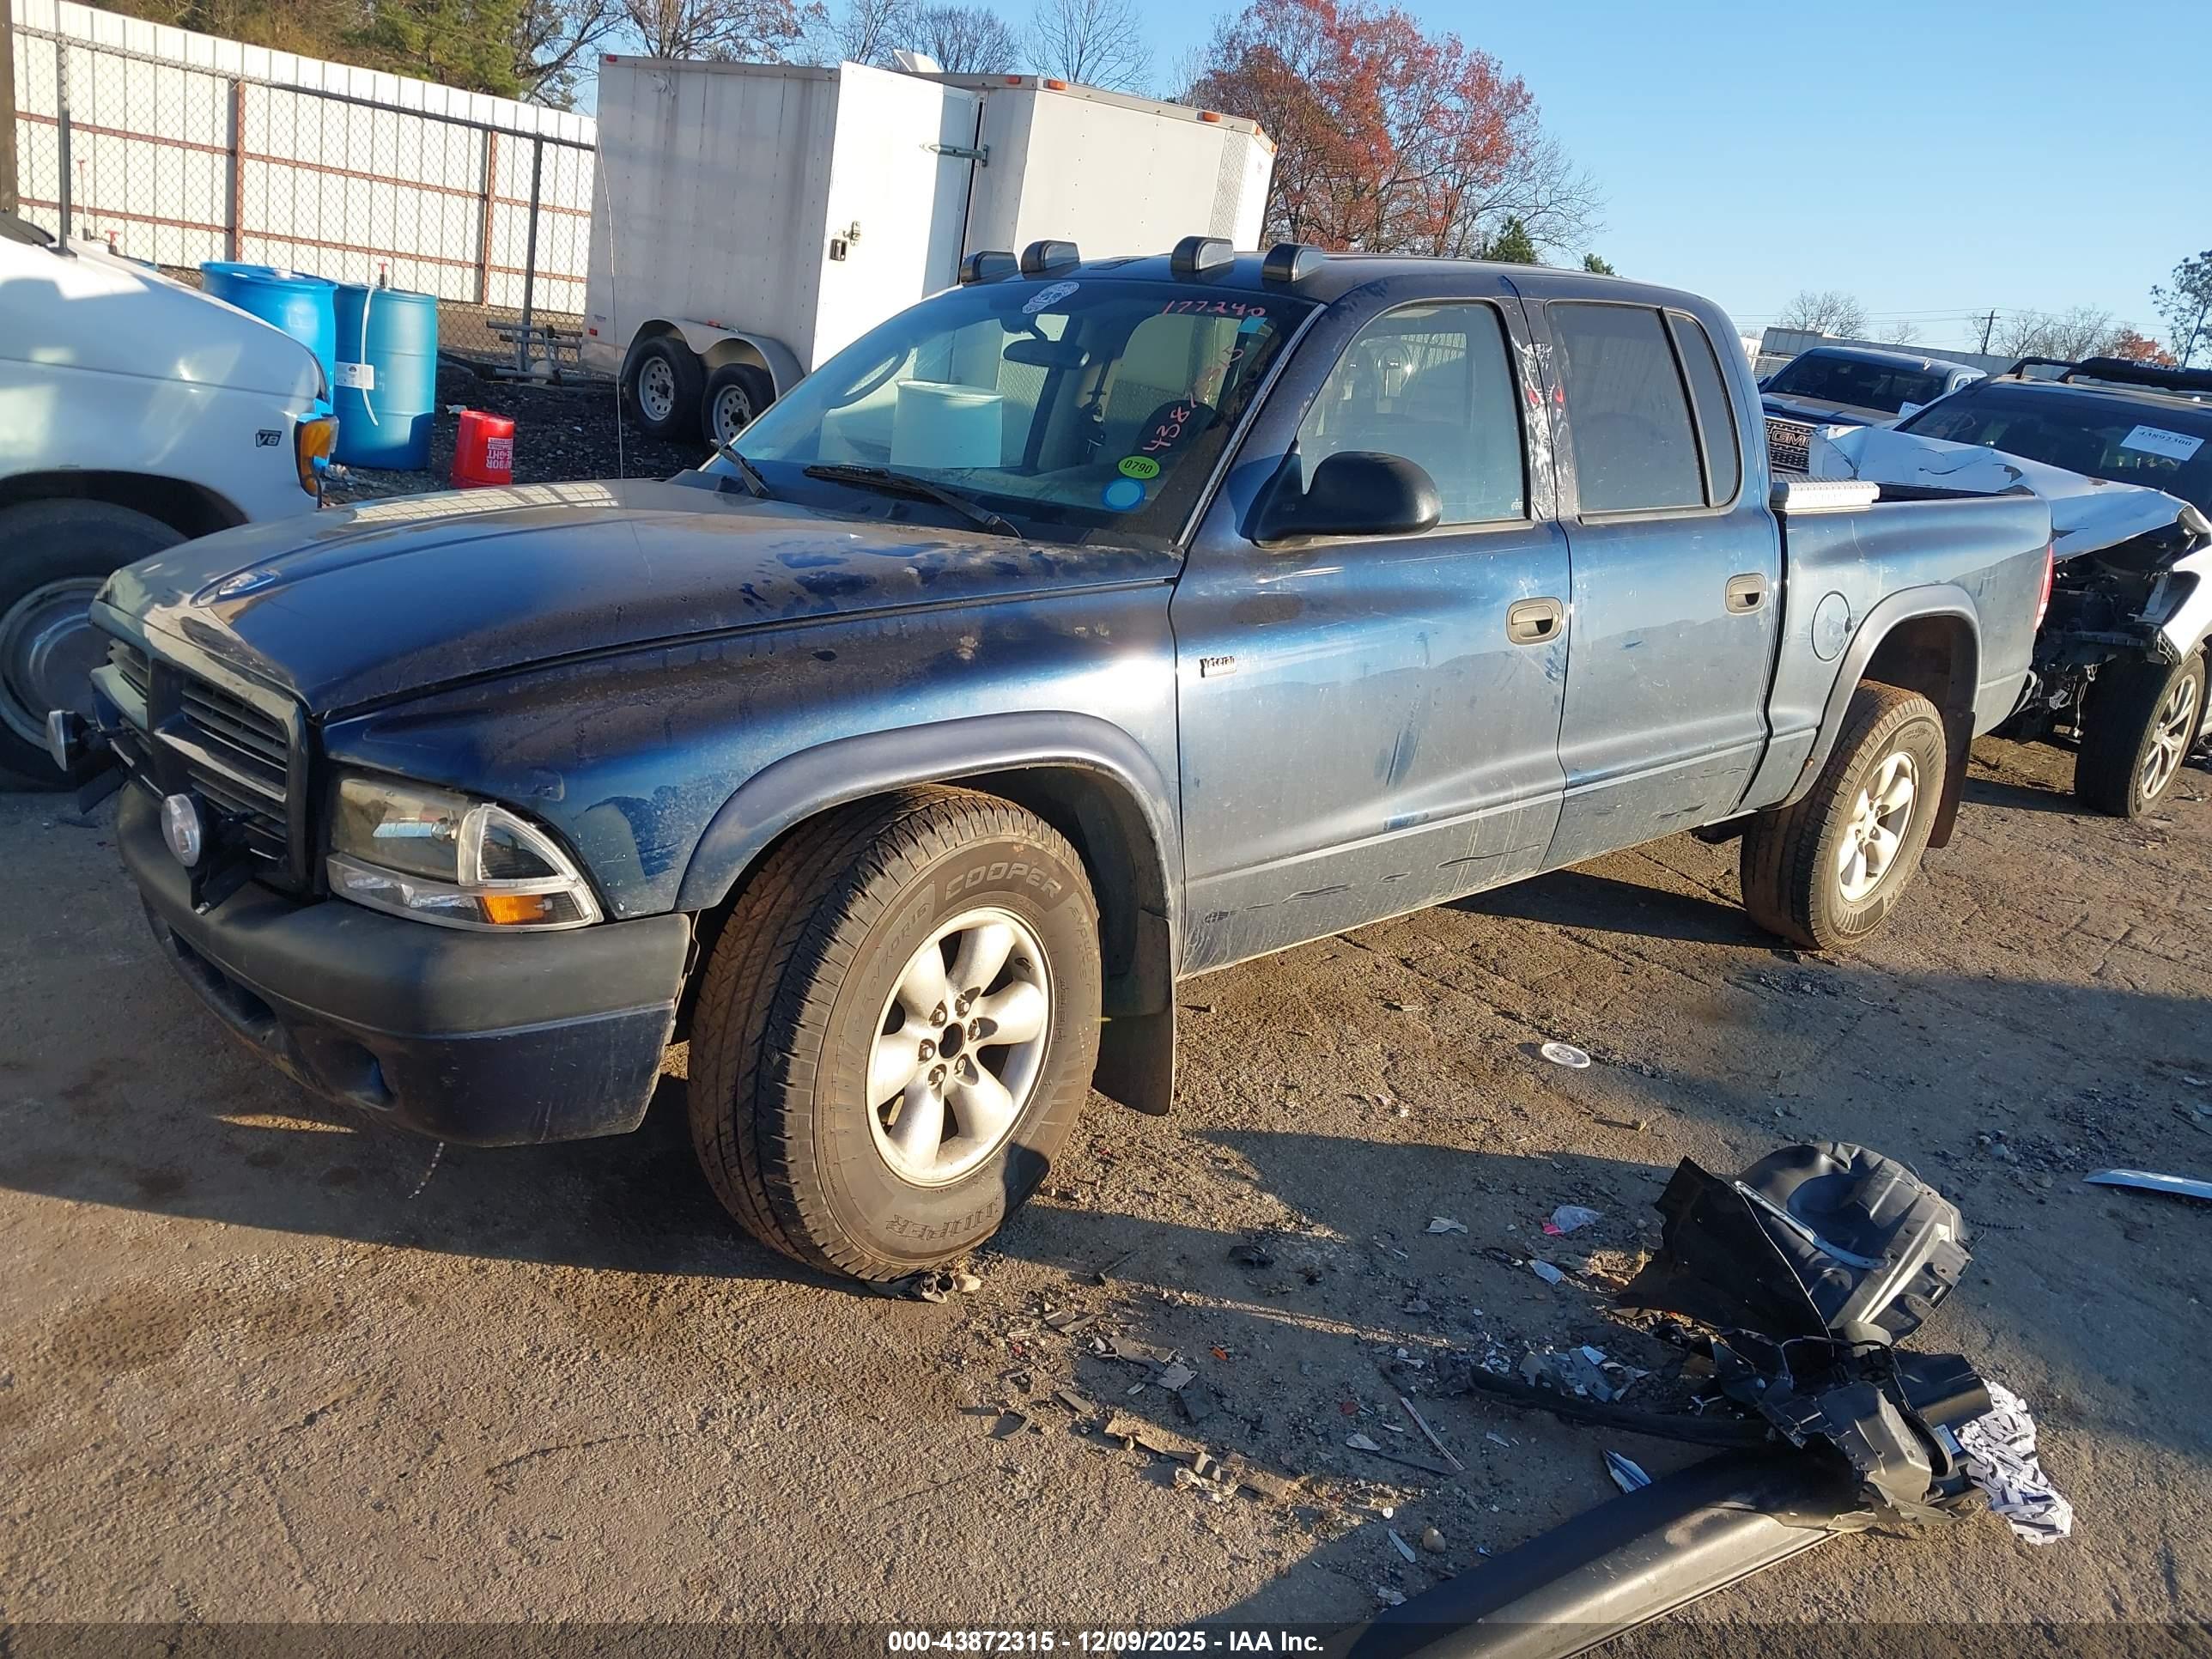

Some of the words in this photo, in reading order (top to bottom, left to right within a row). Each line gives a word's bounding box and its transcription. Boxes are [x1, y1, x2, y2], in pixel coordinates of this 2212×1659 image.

[1162, 300, 1266, 317] 177240
[1124, 459, 1153, 474] 0790
[945, 861, 1063, 900] COOPER
